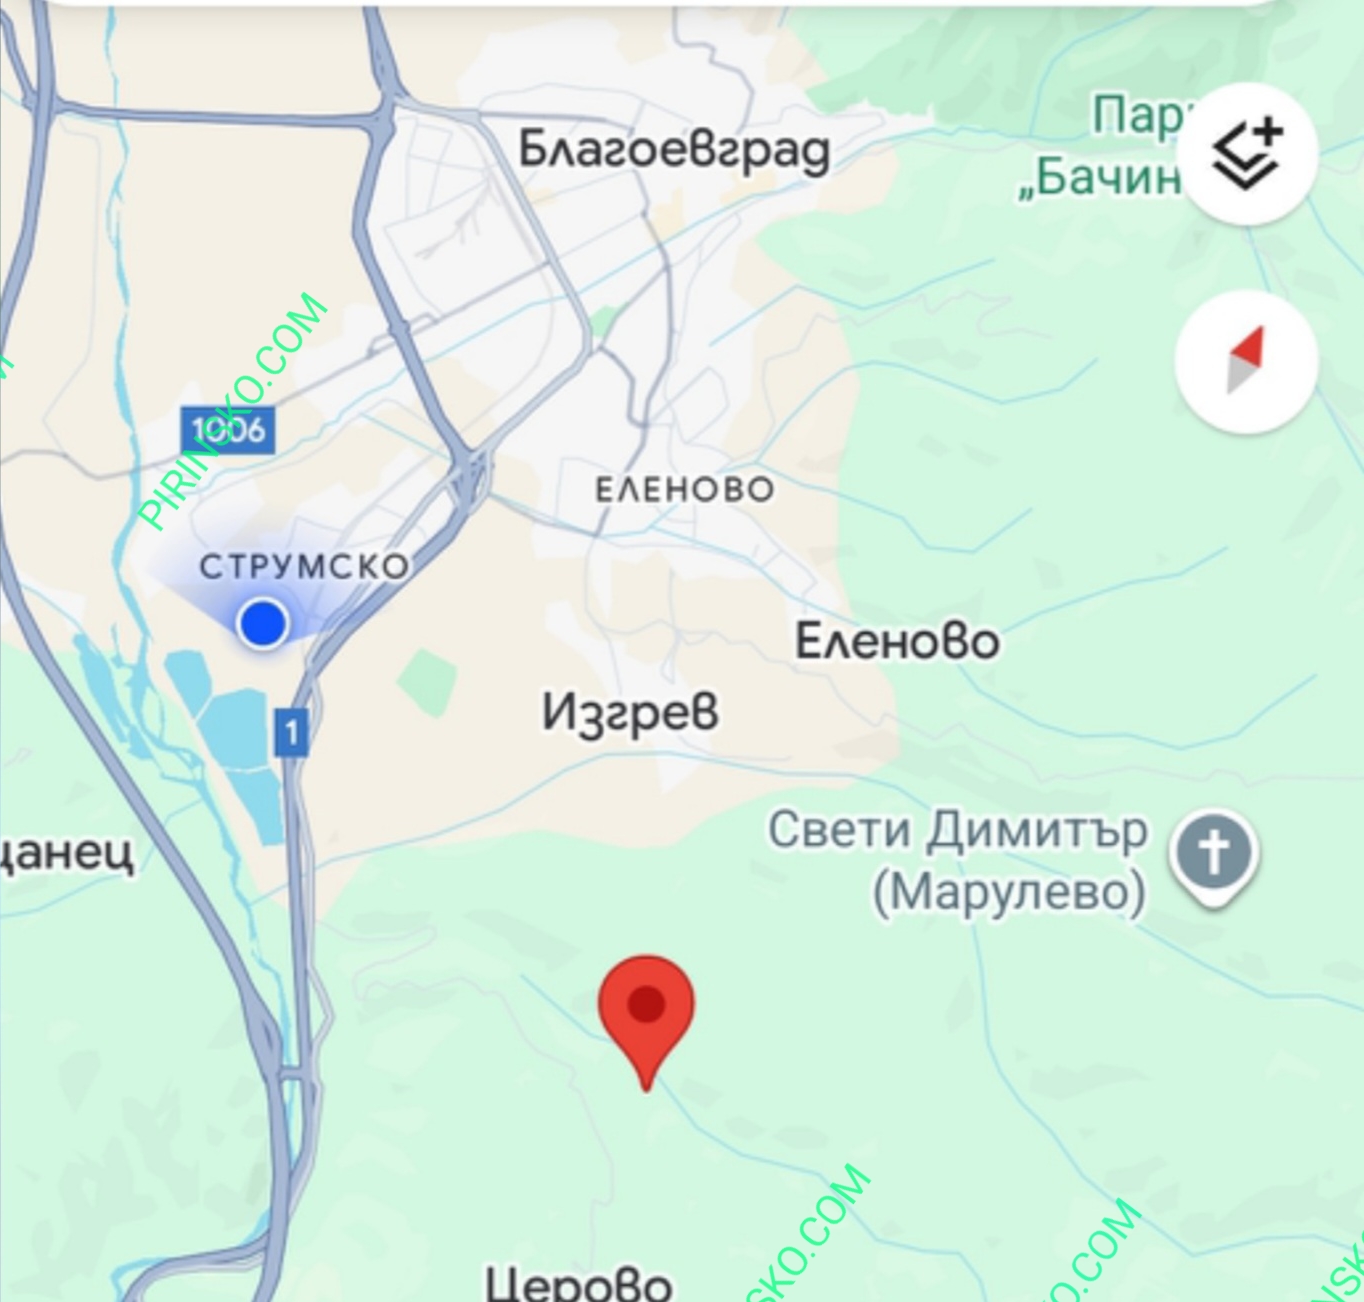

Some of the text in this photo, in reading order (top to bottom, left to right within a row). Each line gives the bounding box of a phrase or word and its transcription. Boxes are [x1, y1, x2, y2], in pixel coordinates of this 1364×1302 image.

[1095, 94, 1194, 142] Пар
[520, 126, 830, 178] Благоевград
[192, 416, 266, 443] 1006
[596, 475, 775, 503] ЕЛЕНОВО
[200, 553, 409, 580] СТРУМСКО
[797, 620, 1000, 660] Еленово
[284, 719, 298, 746] 1
[543, 690, 719, 742] Изгрев
[768, 809, 1148, 858] Свети Димитър
[874, 867, 1145, 920] (Марулево)
